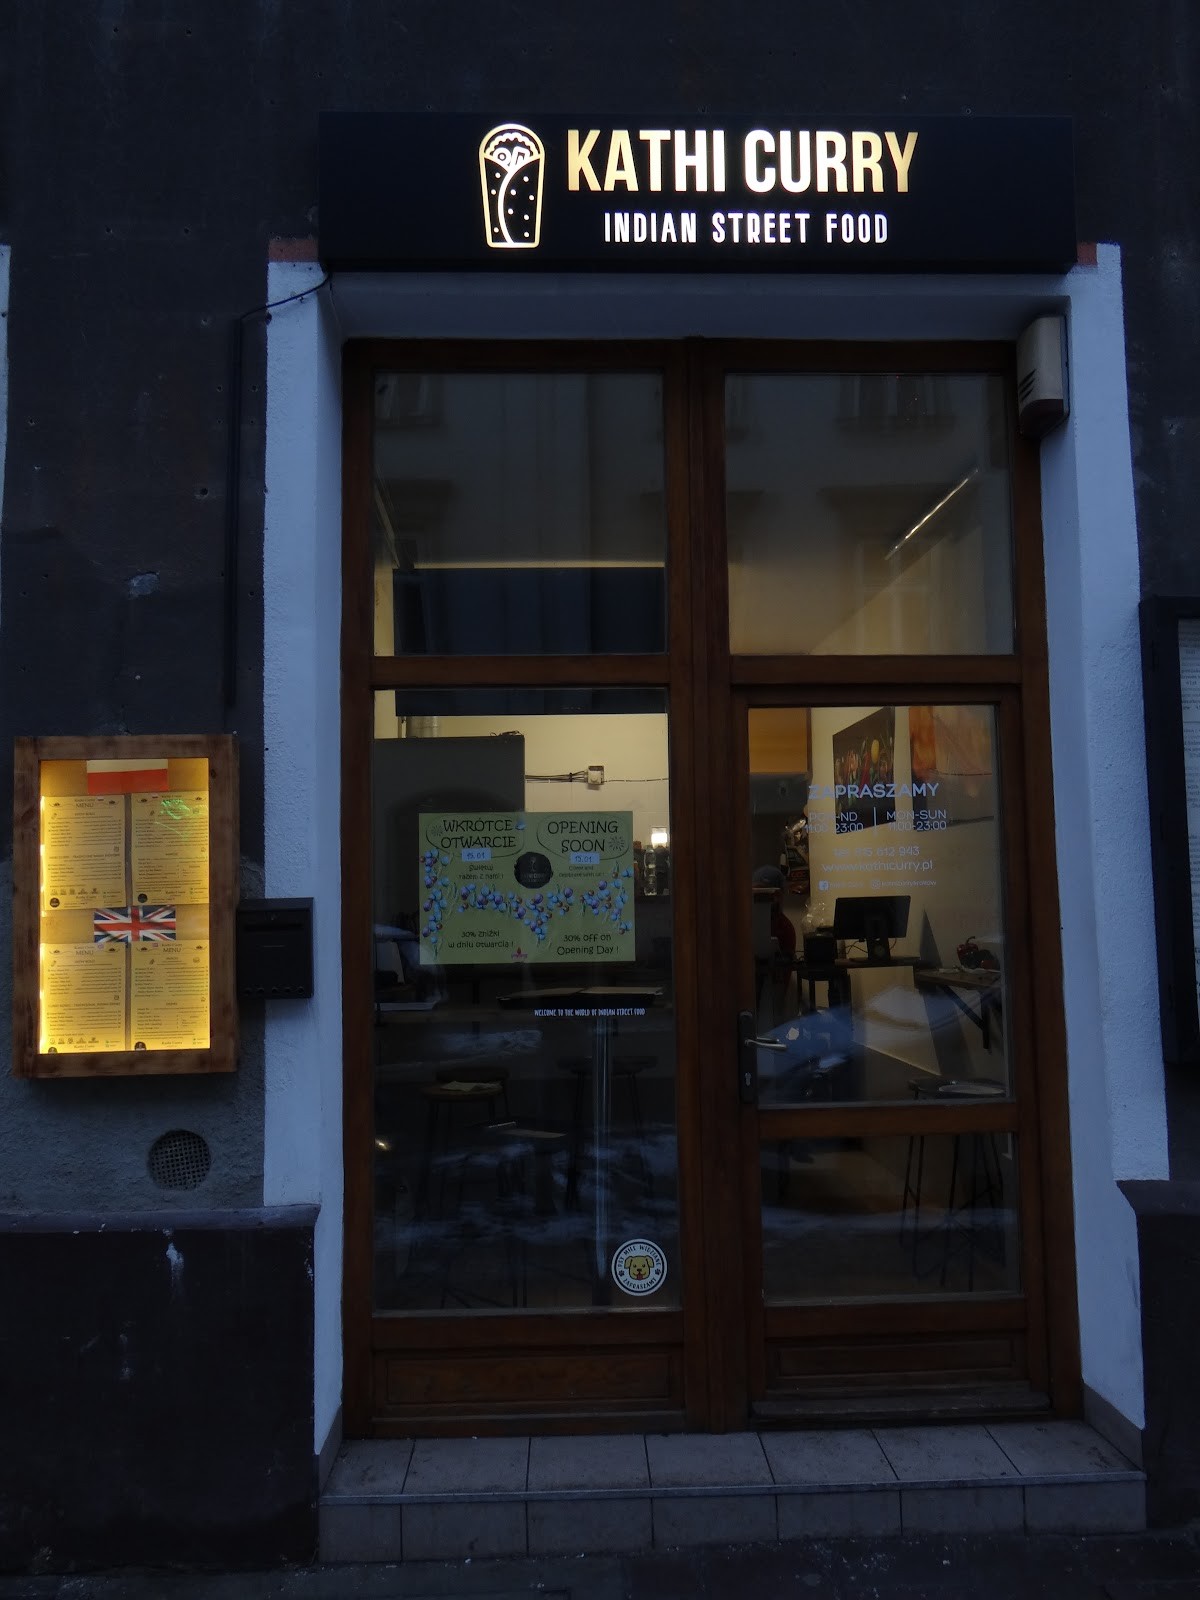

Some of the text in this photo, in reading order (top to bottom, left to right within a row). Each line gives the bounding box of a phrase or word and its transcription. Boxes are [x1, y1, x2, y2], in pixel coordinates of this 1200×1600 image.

[566, 129, 919, 194] KATHI CURRY
[603, 212, 889, 244] INDIAN STREET FOOD
[808, 782, 940, 800] ZAPRASZAMY
[886, 809, 947, 821] MON-SUN
[443, 818, 514, 832] WKRÓTCE
[547, 820, 619, 835] OPENING
[440, 835, 517, 849] OTWARCIE
[561, 838, 606, 853] SOON
[898, 846, 920, 856] 943
[563, 934, 581, 942] 30%
[556, 945, 594, 956] Opening
[596, 945, 614, 955] Day
